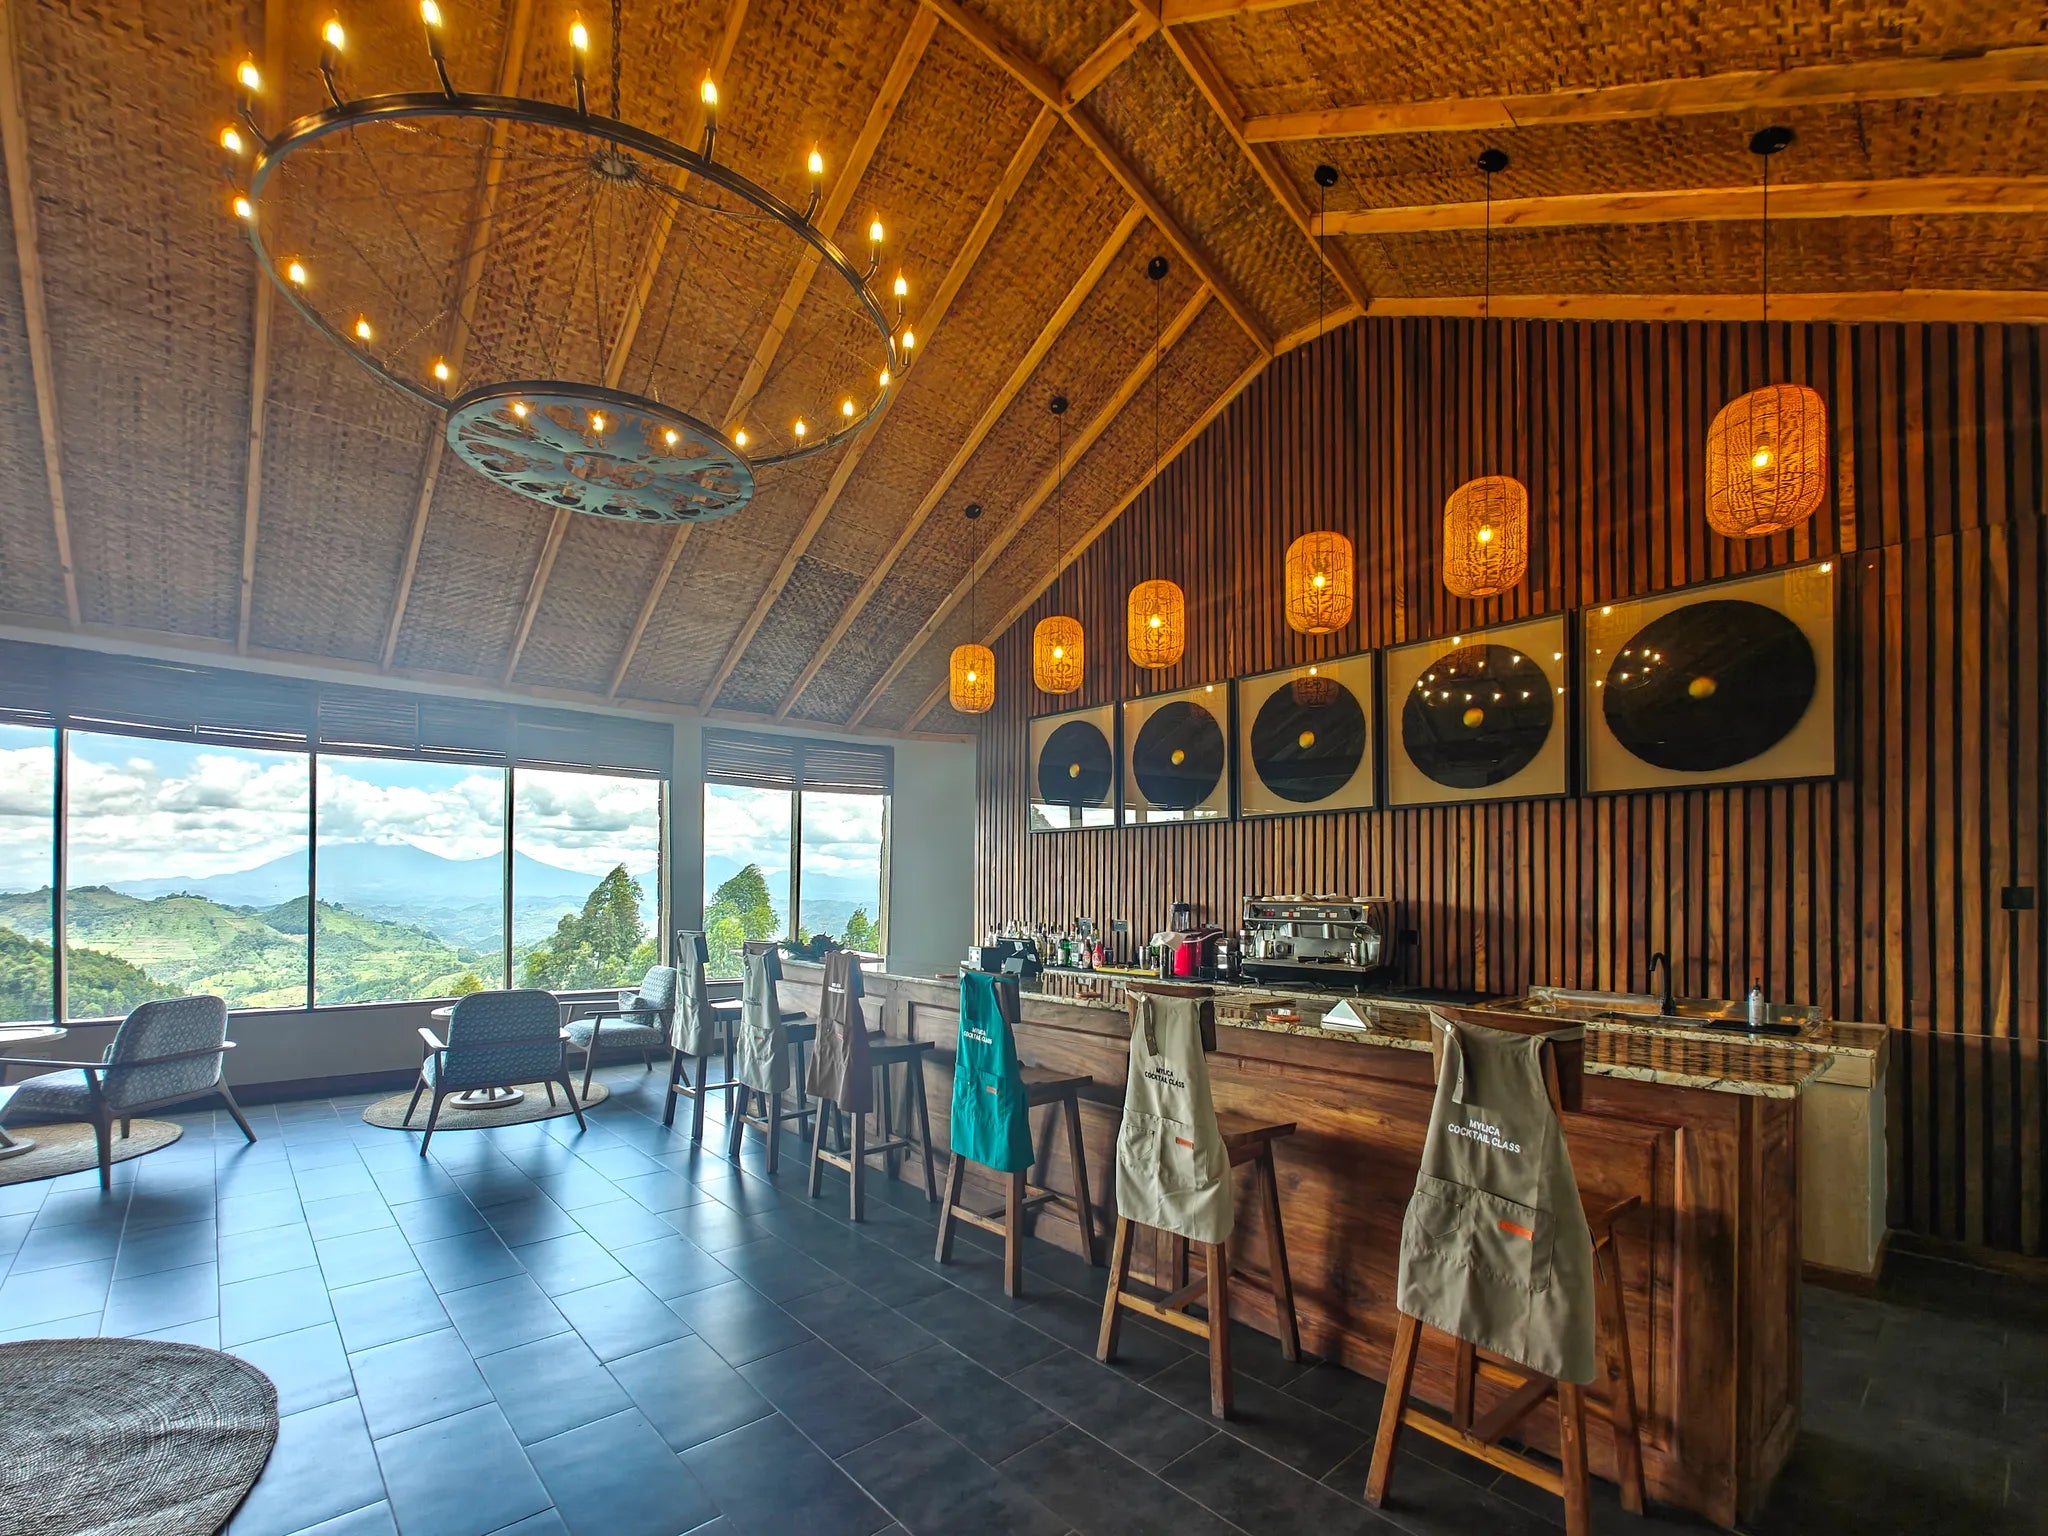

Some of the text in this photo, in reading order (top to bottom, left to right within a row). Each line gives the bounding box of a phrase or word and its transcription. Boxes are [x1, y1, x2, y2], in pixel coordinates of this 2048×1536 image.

[1144, 1071, 1185, 1088] COCKTAIL CLASS
[1469, 1119, 1500, 1136] MYLICA
[1448, 1123, 1521, 1153] COCKTAIL CLASS
